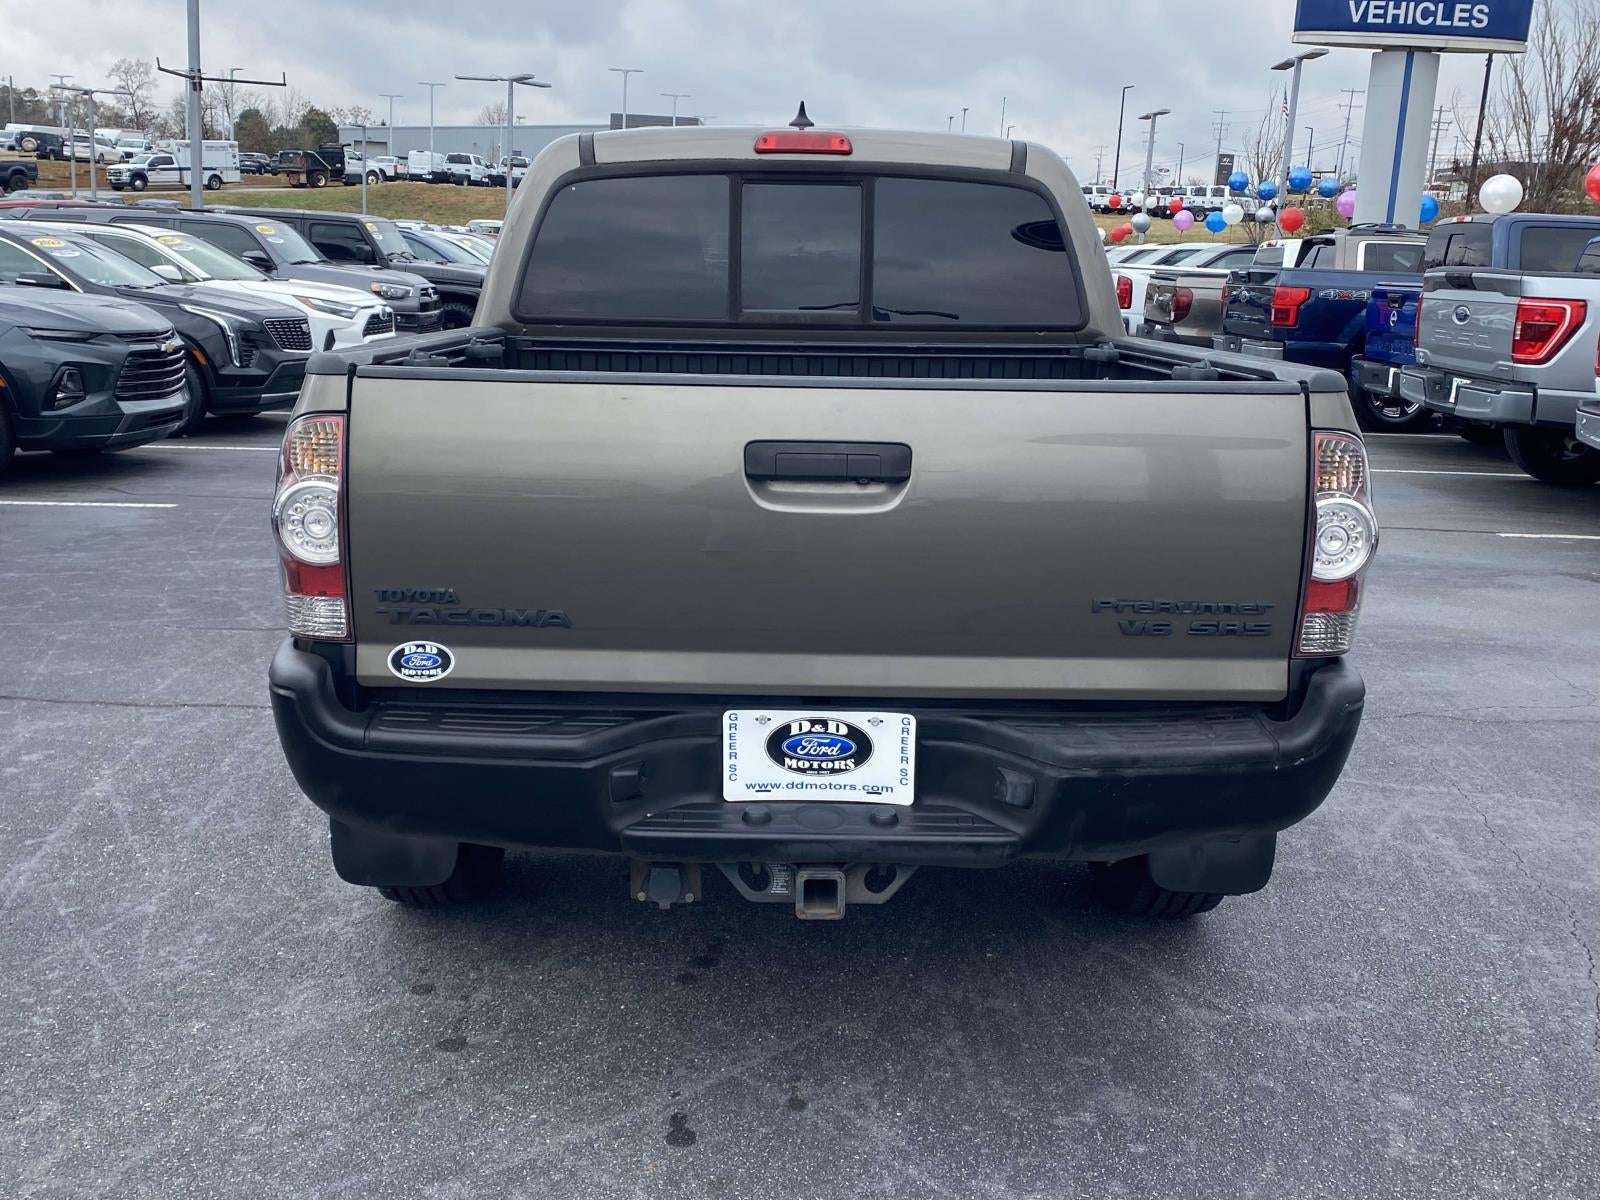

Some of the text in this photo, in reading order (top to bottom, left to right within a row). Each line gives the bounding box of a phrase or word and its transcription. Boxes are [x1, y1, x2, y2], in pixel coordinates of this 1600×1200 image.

[1349, 0, 1490, 29] VEHICLES
[373, 587, 460, 604] TOYOTA
[376, 607, 573, 628] TACOMA
[1118, 619, 1173, 637] V6
[404, 644, 438, 655] D&D
[408, 655, 433, 667] Ford
[401, 667, 442, 676] MOTORS
[789, 719, 849, 736] D&D
[728, 712, 739, 782] GREER SC
[796, 737, 841, 756] Ford
[899, 717, 911, 786] GREER SC
[783, 757, 857, 770] MOTORS
[745, 781, 894, 793] www.ddmotors.com
